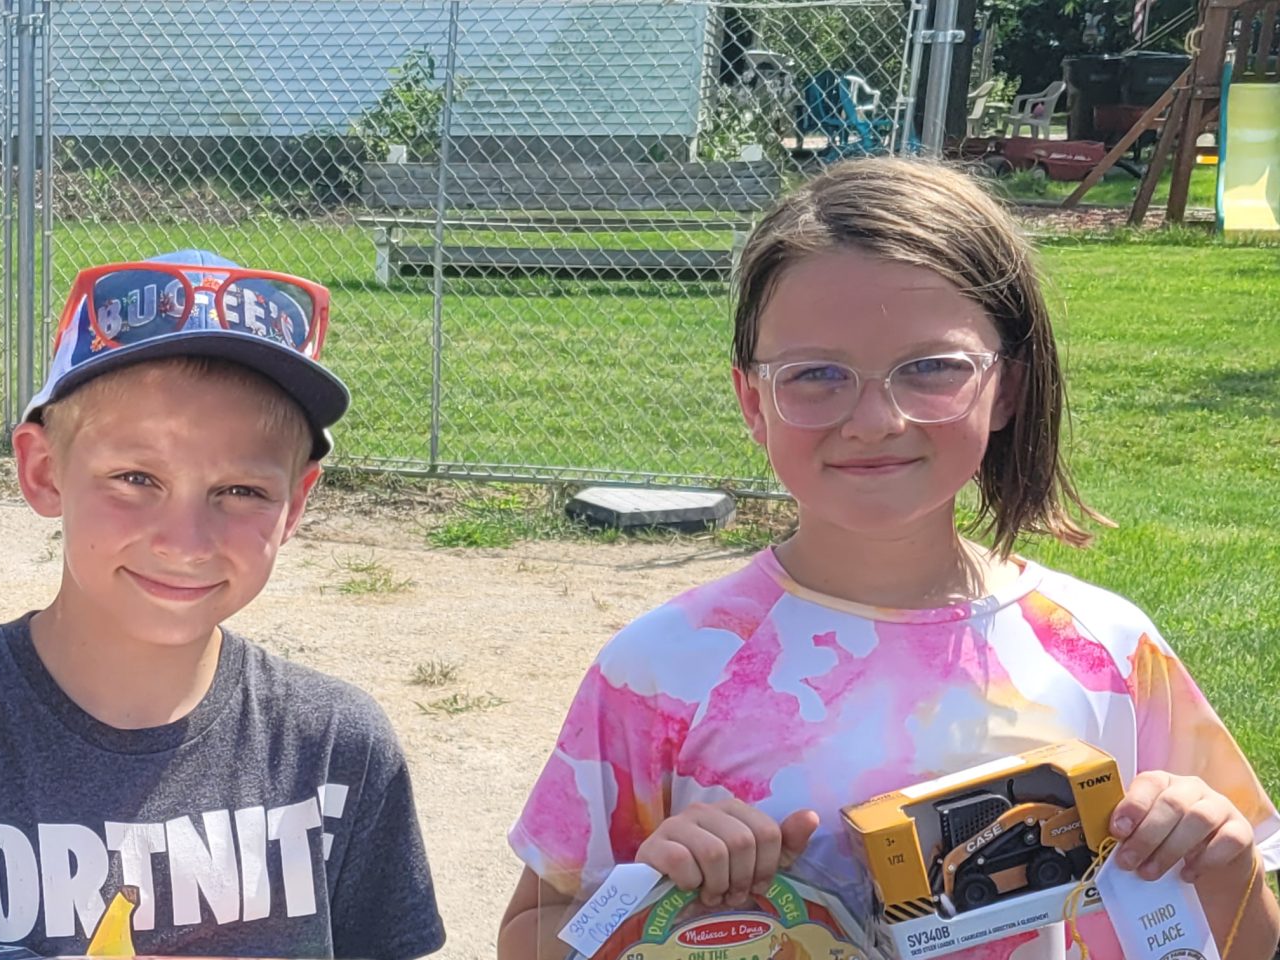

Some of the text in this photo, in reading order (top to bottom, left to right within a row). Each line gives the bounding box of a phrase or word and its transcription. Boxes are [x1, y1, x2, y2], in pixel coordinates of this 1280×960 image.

[1078, 773, 1112, 790] TOMY
[966, 823, 1002, 852] CASE
[620, 893, 638, 907] C
[1138, 903, 1176, 930] THIRD
[685, 929, 729, 944] Melissa
[739, 925, 764, 938] Doug
[907, 926, 951, 948] SV340B
[1147, 922, 1185, 951] PLACE
